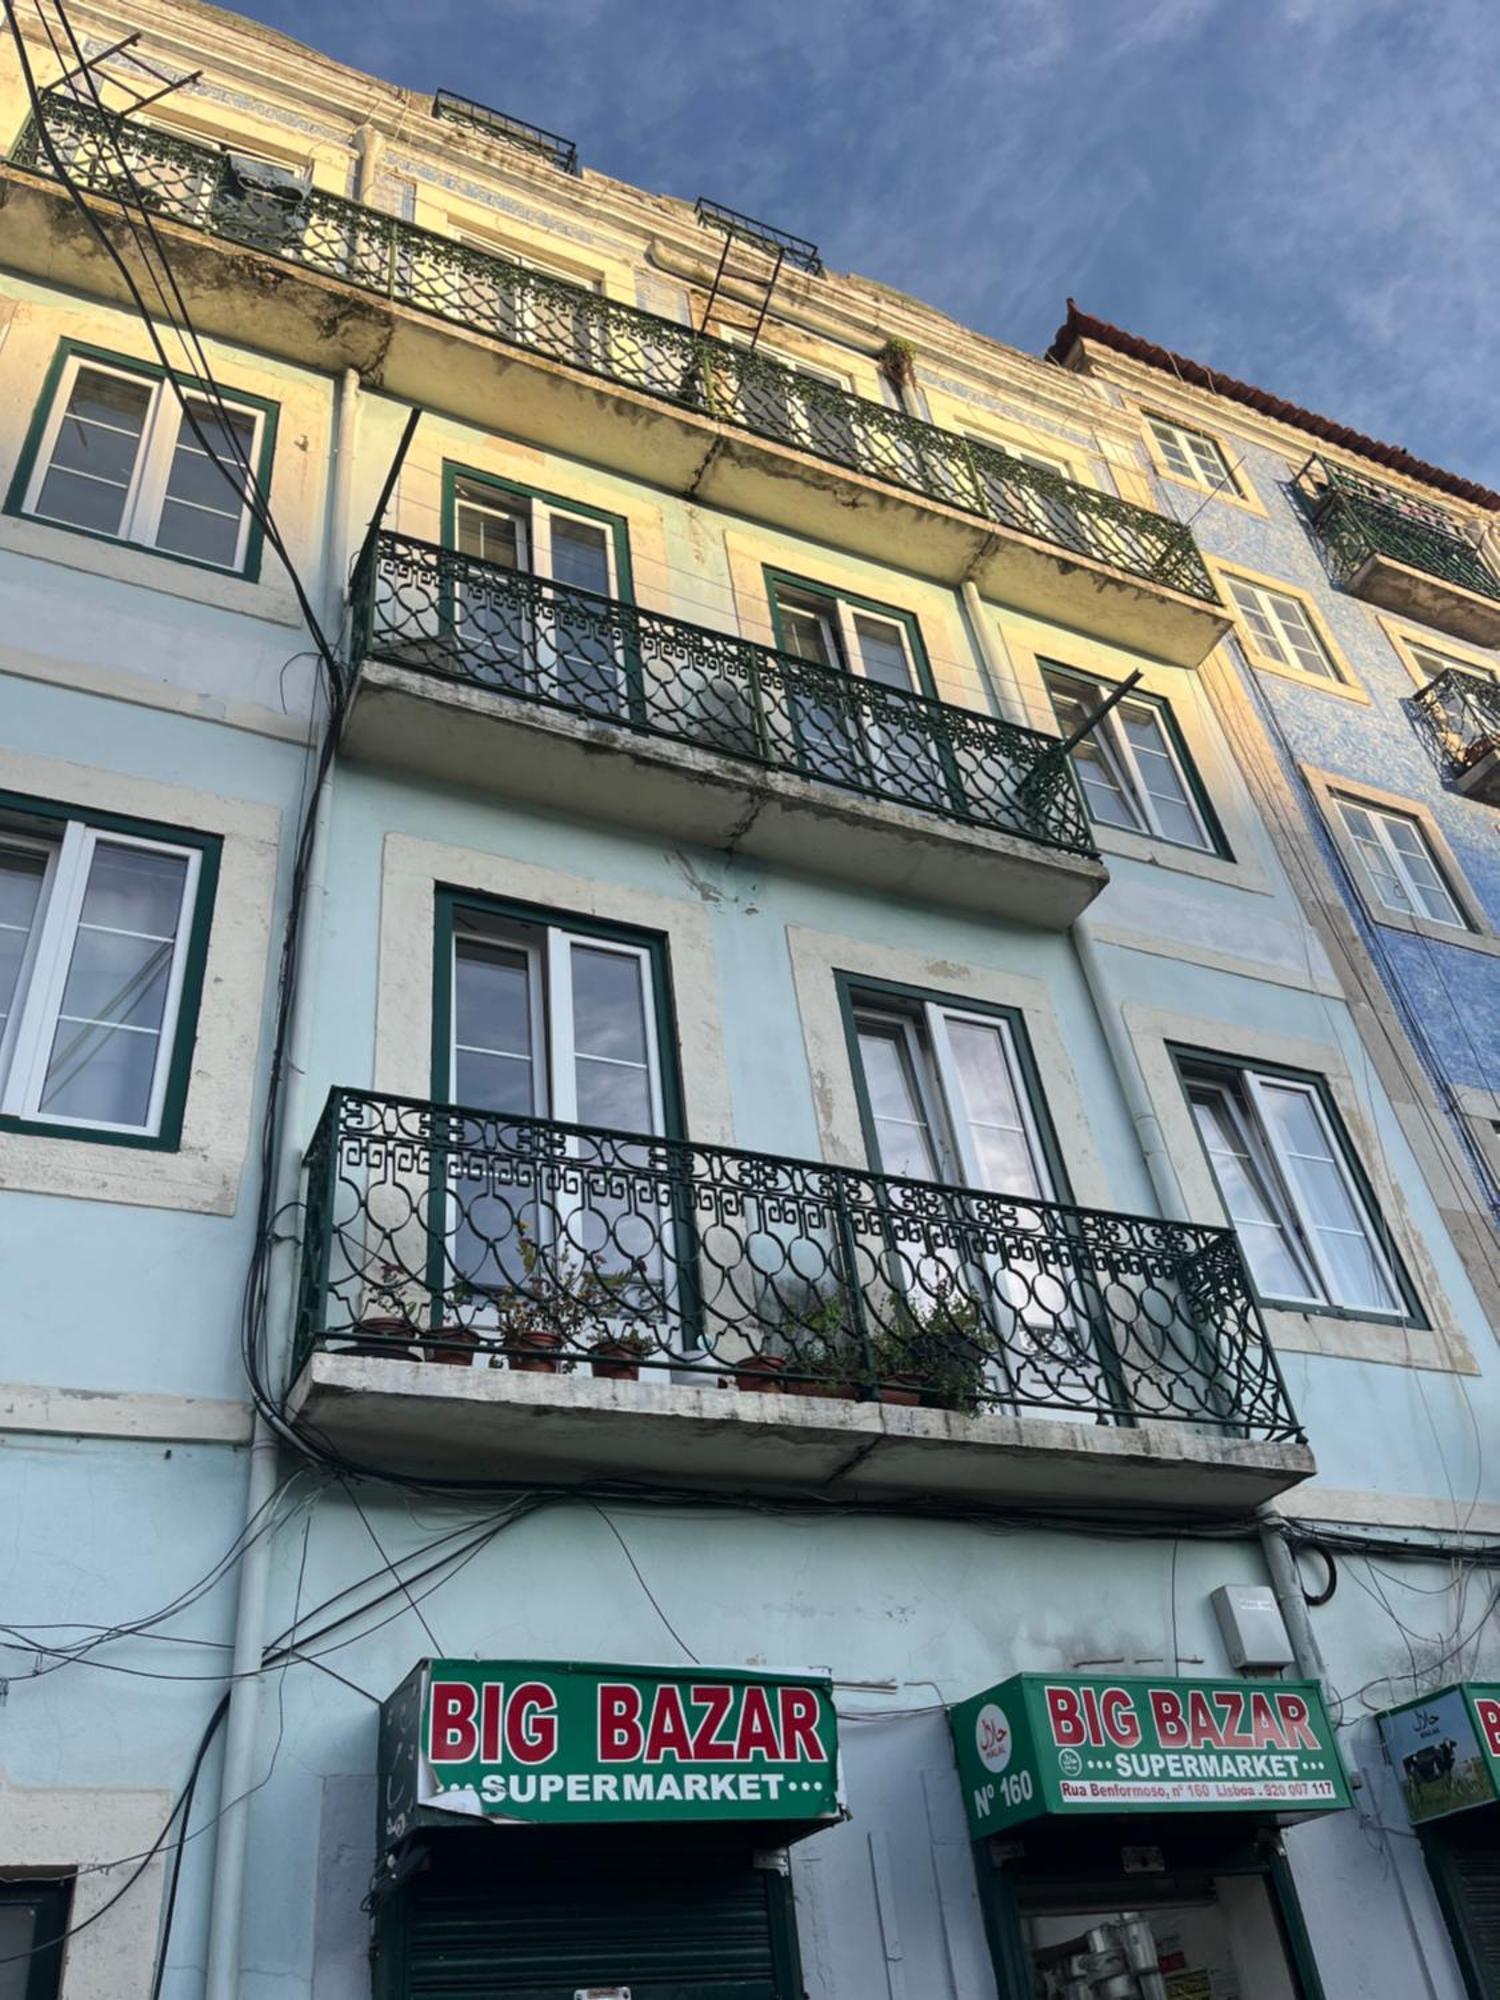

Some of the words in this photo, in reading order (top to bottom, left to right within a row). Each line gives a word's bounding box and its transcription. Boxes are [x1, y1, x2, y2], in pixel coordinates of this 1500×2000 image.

[428, 1681, 559, 1765] BIG
[597, 1682, 828, 1764] BAZAR
[1045, 1686, 1142, 1749] BIG
[1148, 1689, 1322, 1750] BAZAR
[1000, 1770, 1033, 1808] 160
[1062, 1782, 1088, 1797] Rua
[1089, 1783, 1171, 1799] Benformoso,
[1187, 1784, 1210, 1798] 160
[1215, 1784, 1256, 1797] Lisboa
[1311, 1781, 1332, 1795] 117
